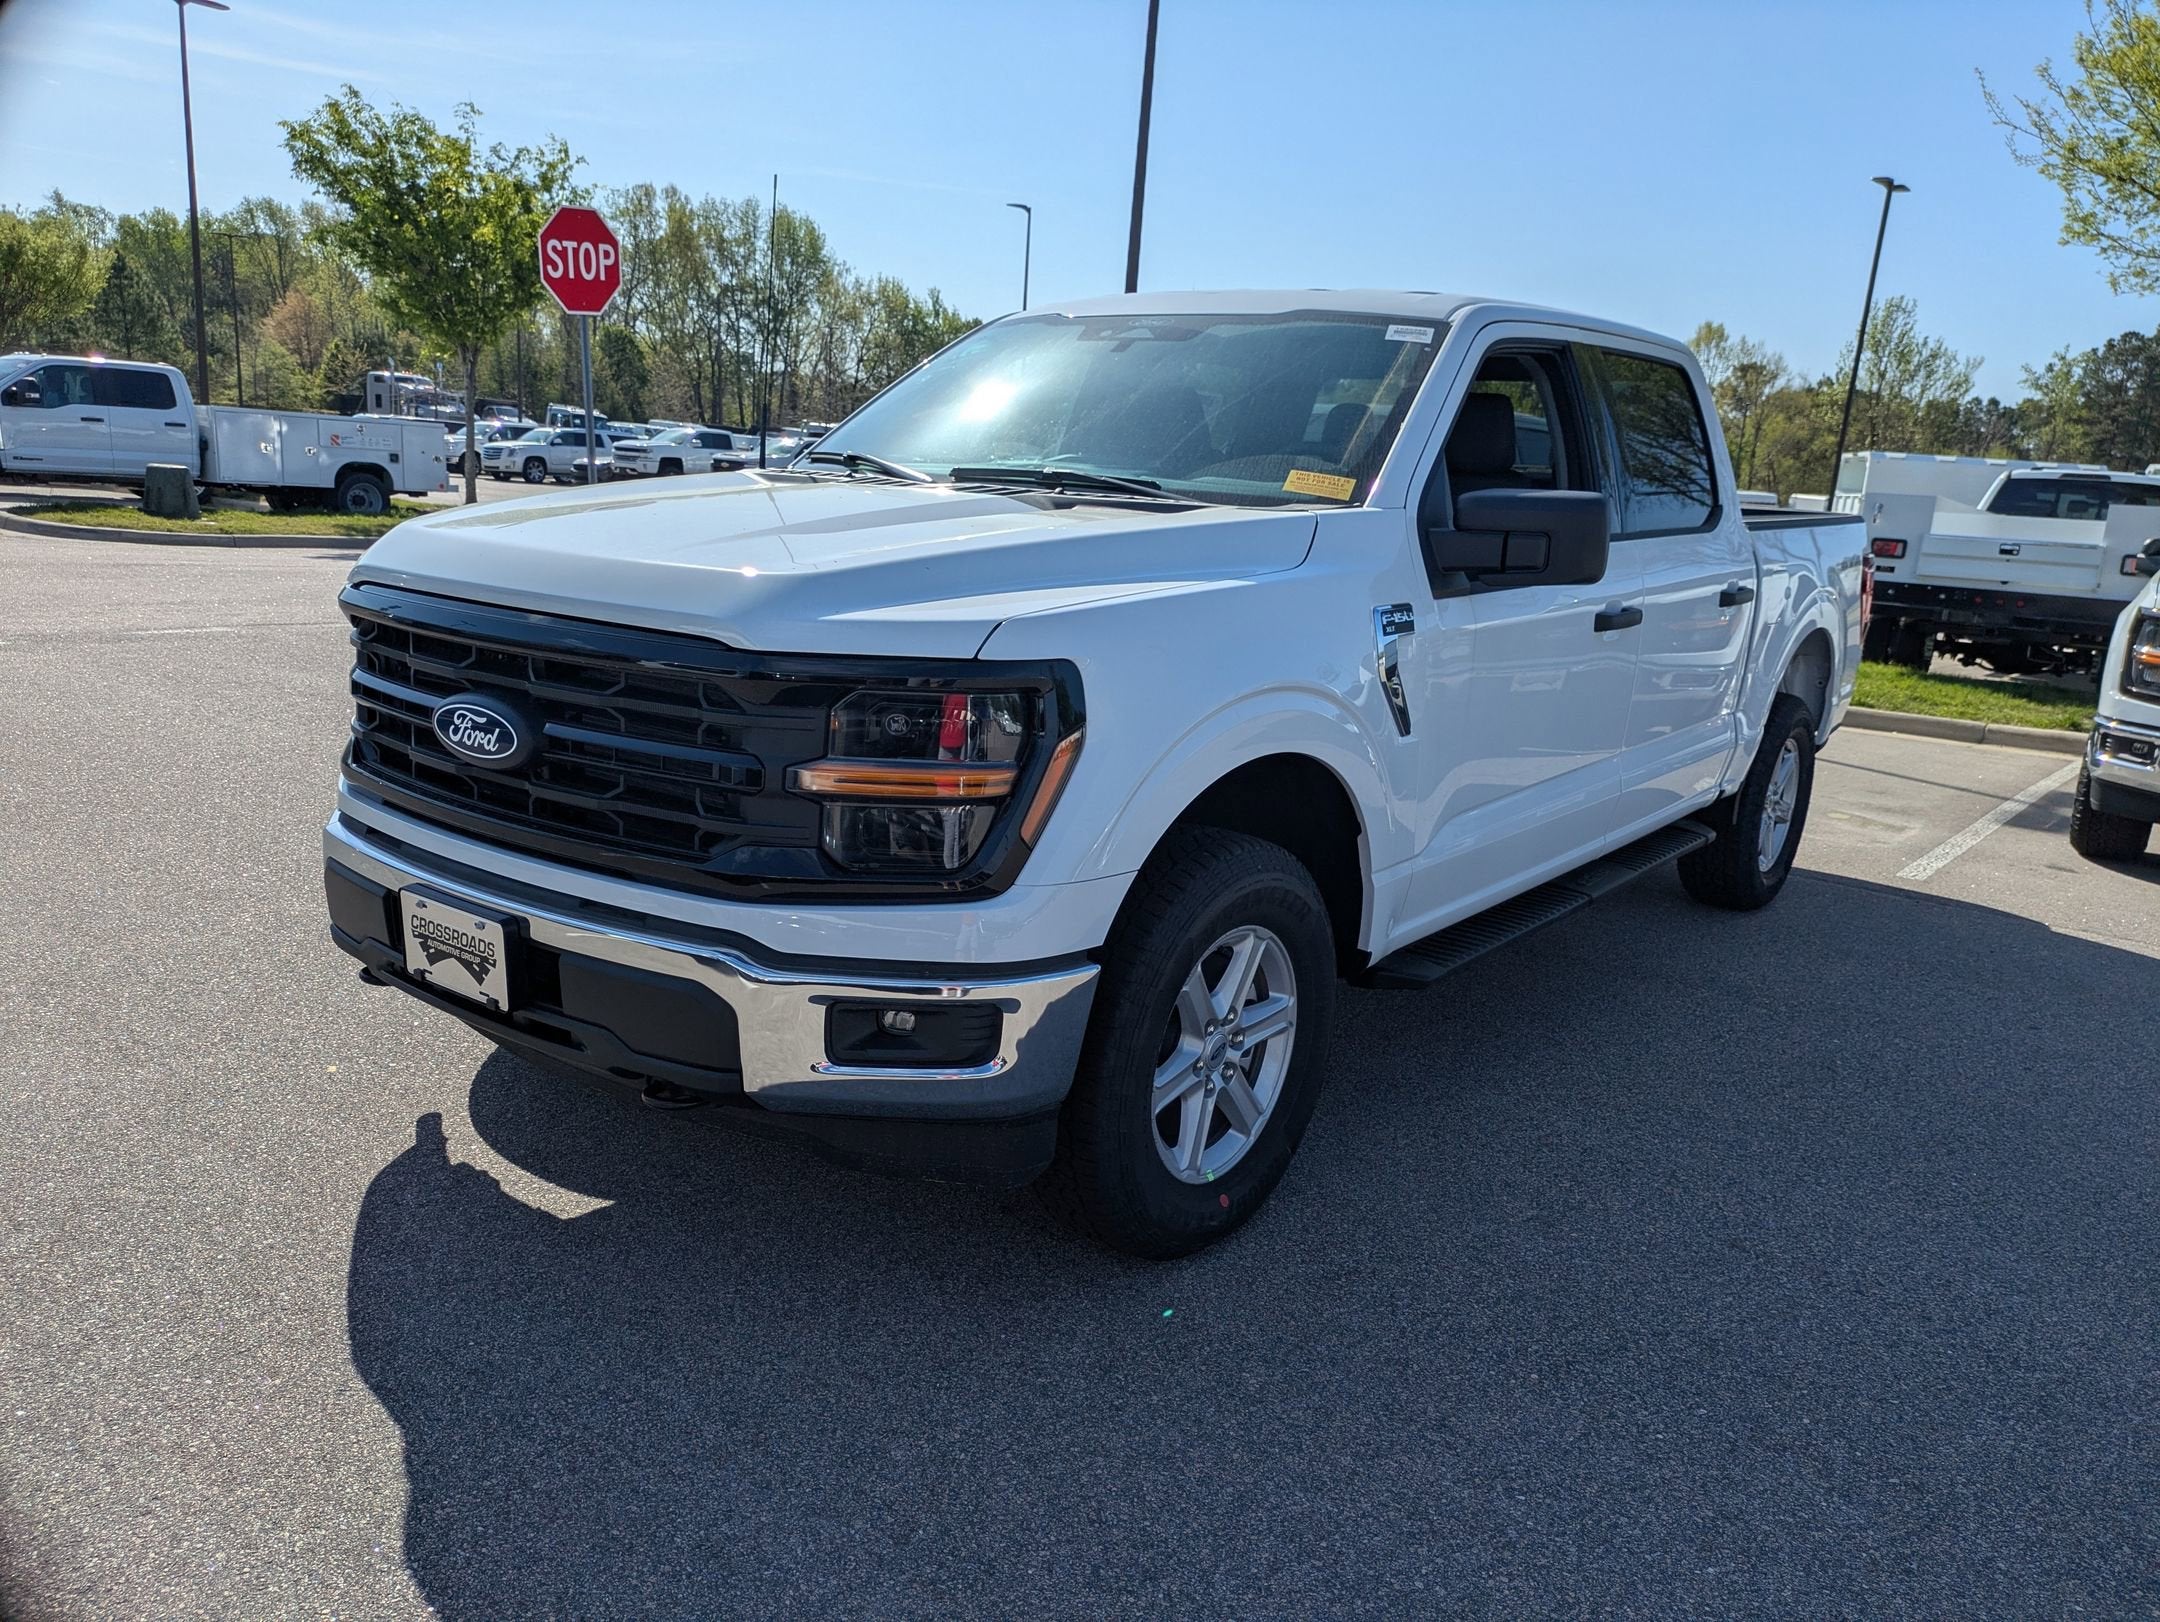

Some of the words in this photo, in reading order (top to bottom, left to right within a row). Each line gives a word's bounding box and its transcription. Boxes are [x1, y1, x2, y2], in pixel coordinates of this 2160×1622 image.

[546, 239, 616, 281] STOP
[1312, 474, 1342, 482] VEHICLE
[449, 710, 500, 752] Ford
[411, 914, 495, 958] CROSSROADS
[427, 939, 461, 957] AUTOMOTIVE
[460, 951, 481, 965] GROUP
